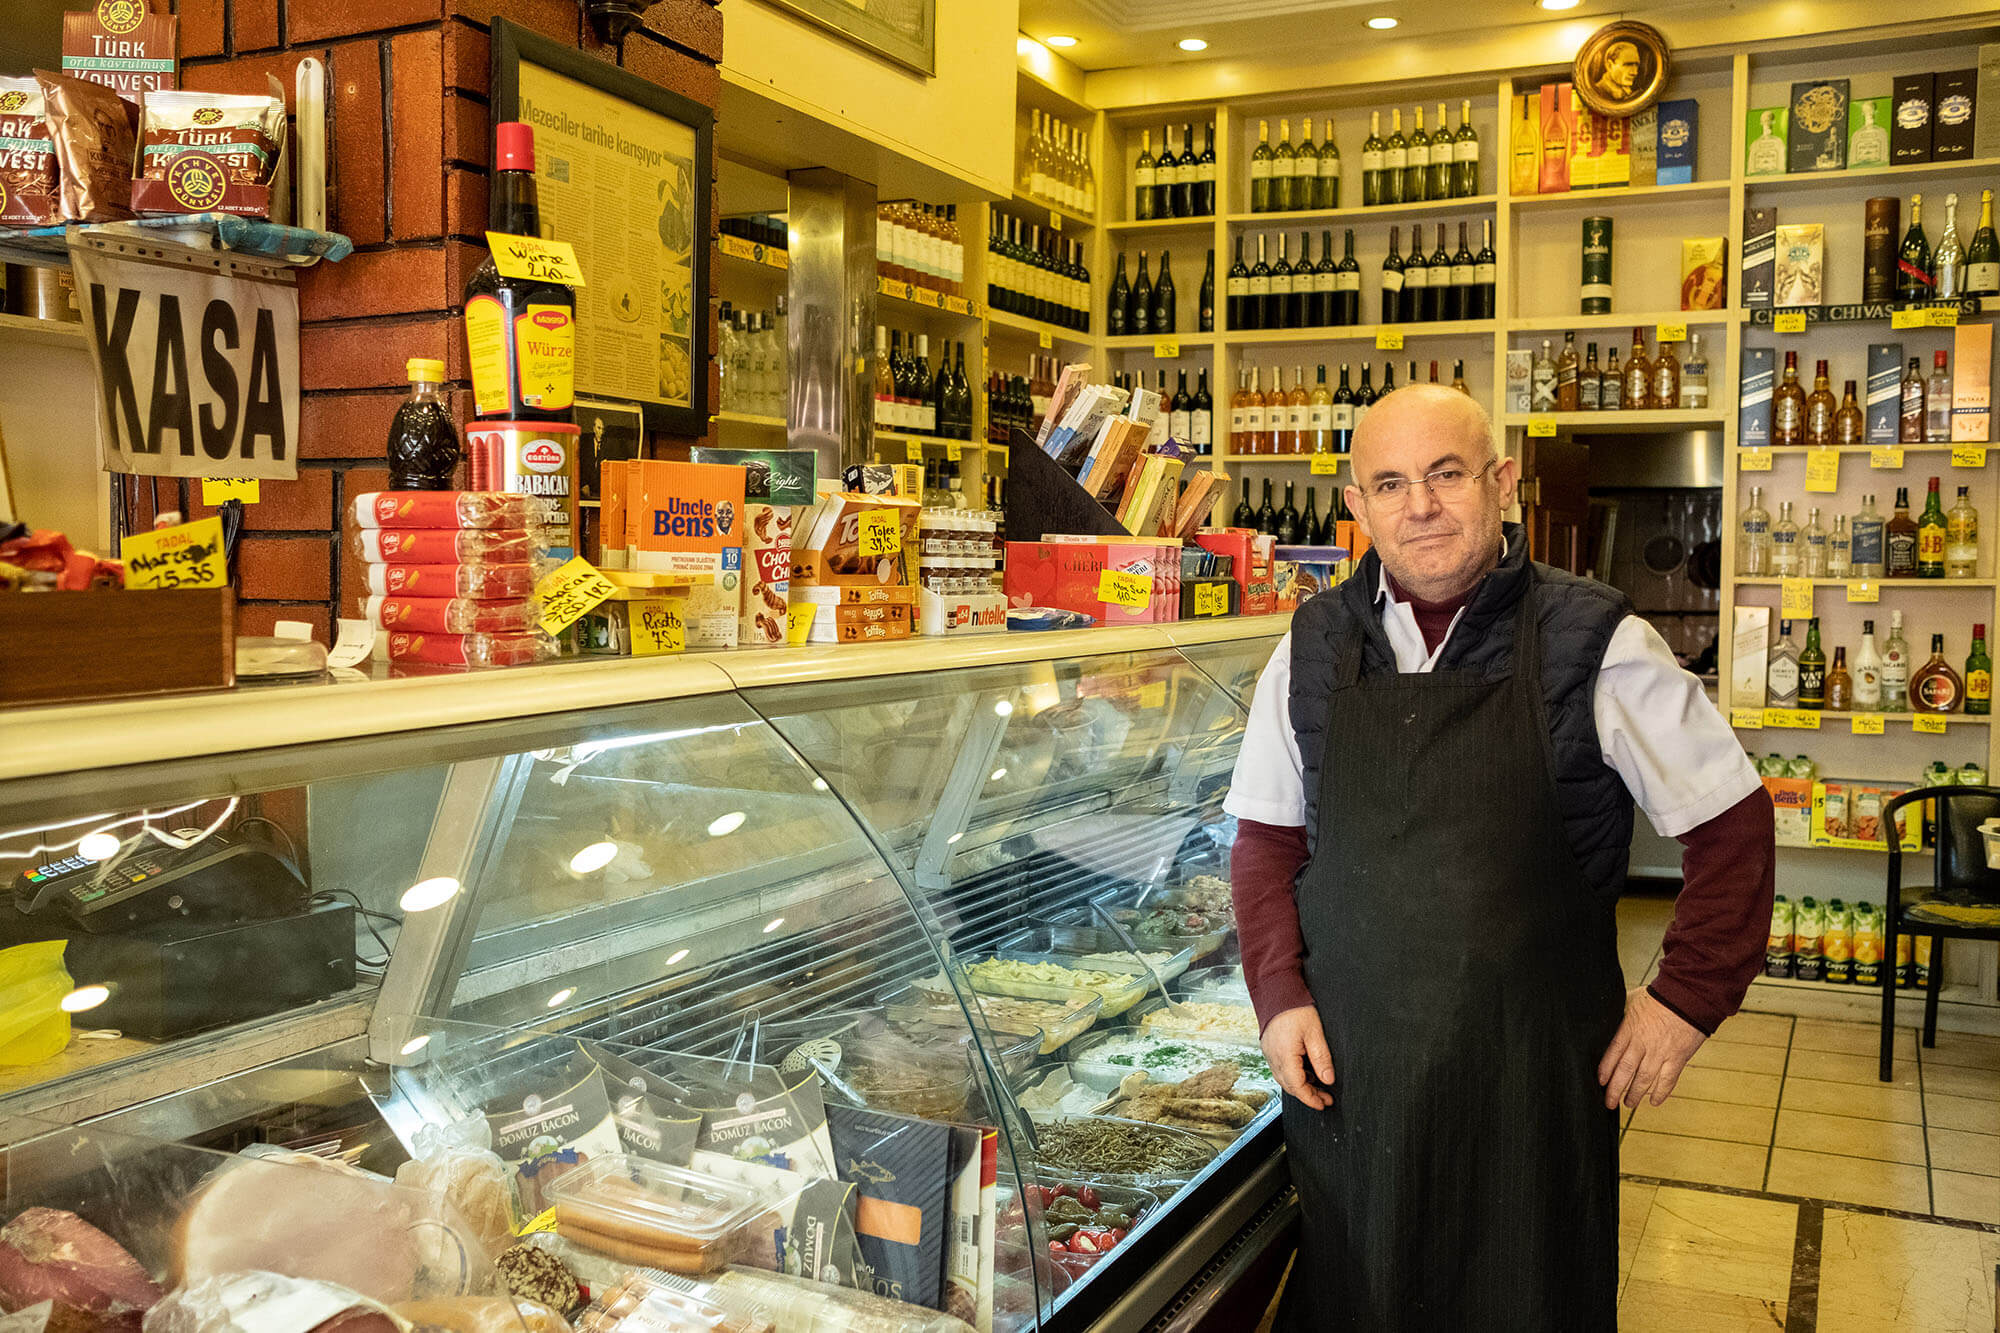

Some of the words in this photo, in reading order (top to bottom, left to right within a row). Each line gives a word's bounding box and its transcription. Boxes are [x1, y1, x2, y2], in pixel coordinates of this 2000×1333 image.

[92, 35, 145, 58] TÜRK
[69, 58, 96, 67] orta
[2, 118, 31, 139] RK
[519, 97, 579, 137] Mezeciler
[581, 122, 615, 150] tarihe
[176, 128, 233, 145] TÜRK
[0, 152, 47, 171] VESİ
[174, 159, 220, 179] KAHVE
[175, 187, 220, 206] DÜNYASI
[1829, 303, 1895, 321] CHIVAS
[527, 341, 572, 358] Würze
[90, 282, 287, 463] KASA
[516, 474, 569, 495] BABACAN
[763, 471, 801, 491] Eight
[668, 497, 712, 516] Uncle
[654, 510, 714, 538] Ben's
[726, 553, 738, 564] 10
[772, 566, 790, 580] CHI
[971, 605, 1006, 626] nutella
[1801, 671, 1823, 681] VAT
[1825, 961, 1849, 971] Cappy
[1854, 963, 1878, 973] Cappy
[1916, 967, 1929, 977] Cap
[499, 1124, 540, 1147] DOMUZ
[541, 1111, 580, 1133] BACON
[711, 1125, 751, 1143] DOMUZ
[803, 1215, 817, 1273] DOMUZ
